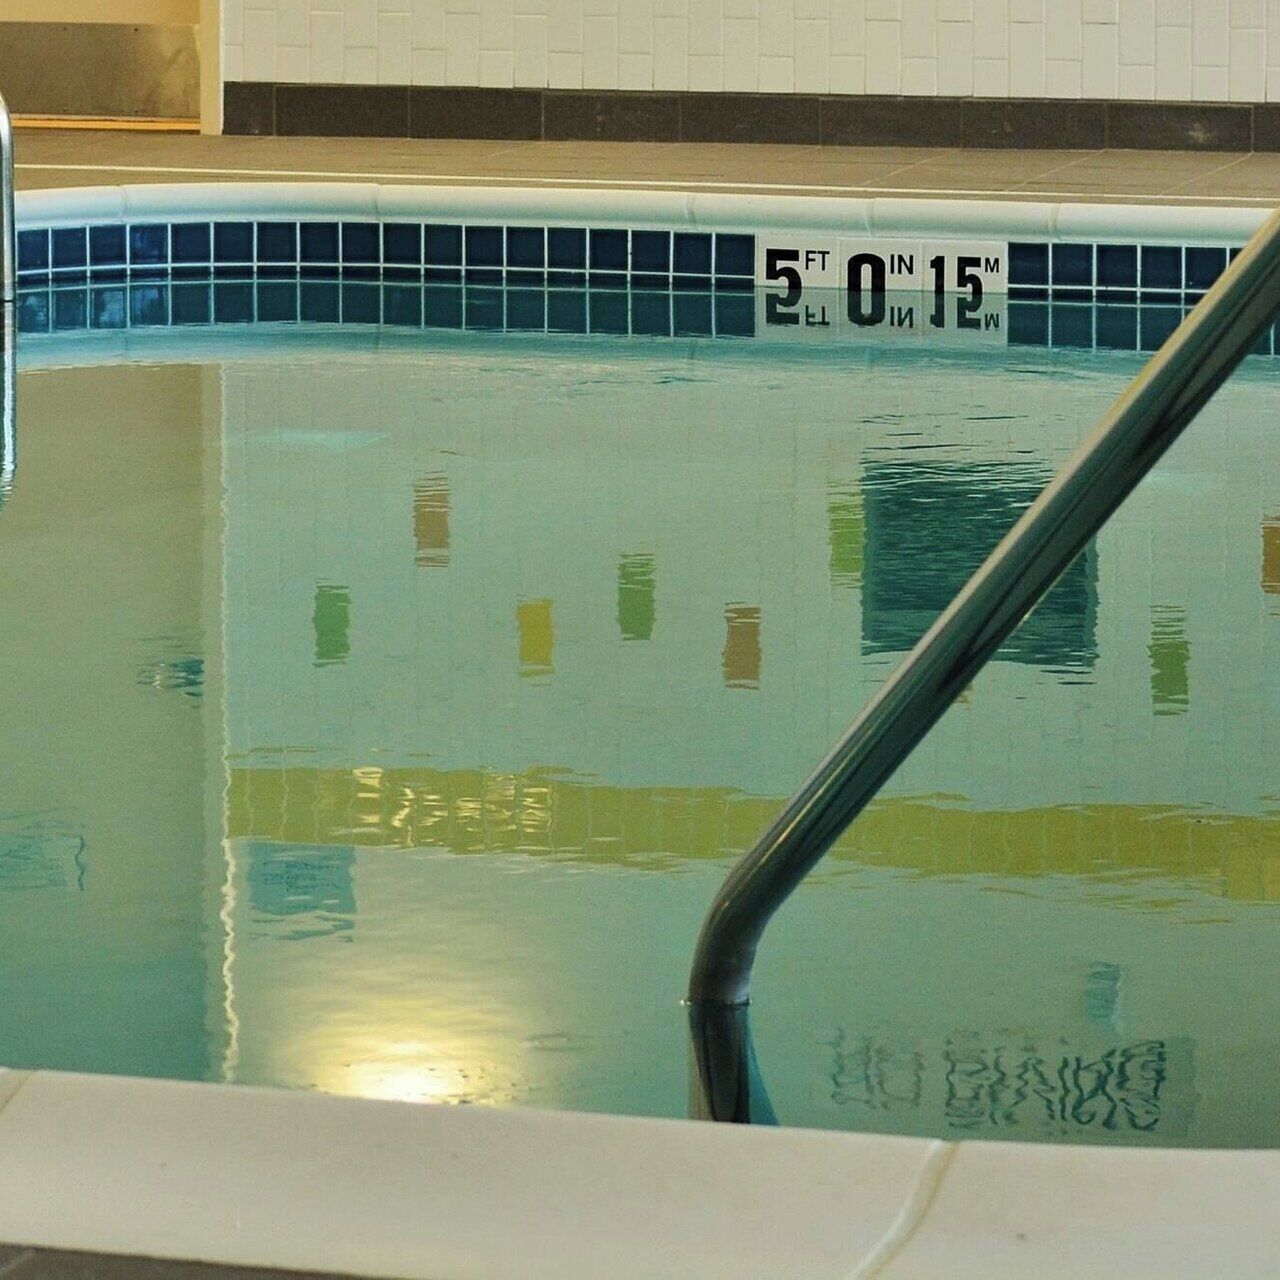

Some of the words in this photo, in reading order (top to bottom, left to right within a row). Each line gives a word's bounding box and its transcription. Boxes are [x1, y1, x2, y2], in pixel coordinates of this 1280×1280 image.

[765, 248, 802, 287] 5
[806, 250, 830, 271] FT
[847, 253, 886, 291] 0
[890, 254, 913, 275] IN
[985, 258, 999, 273] M
